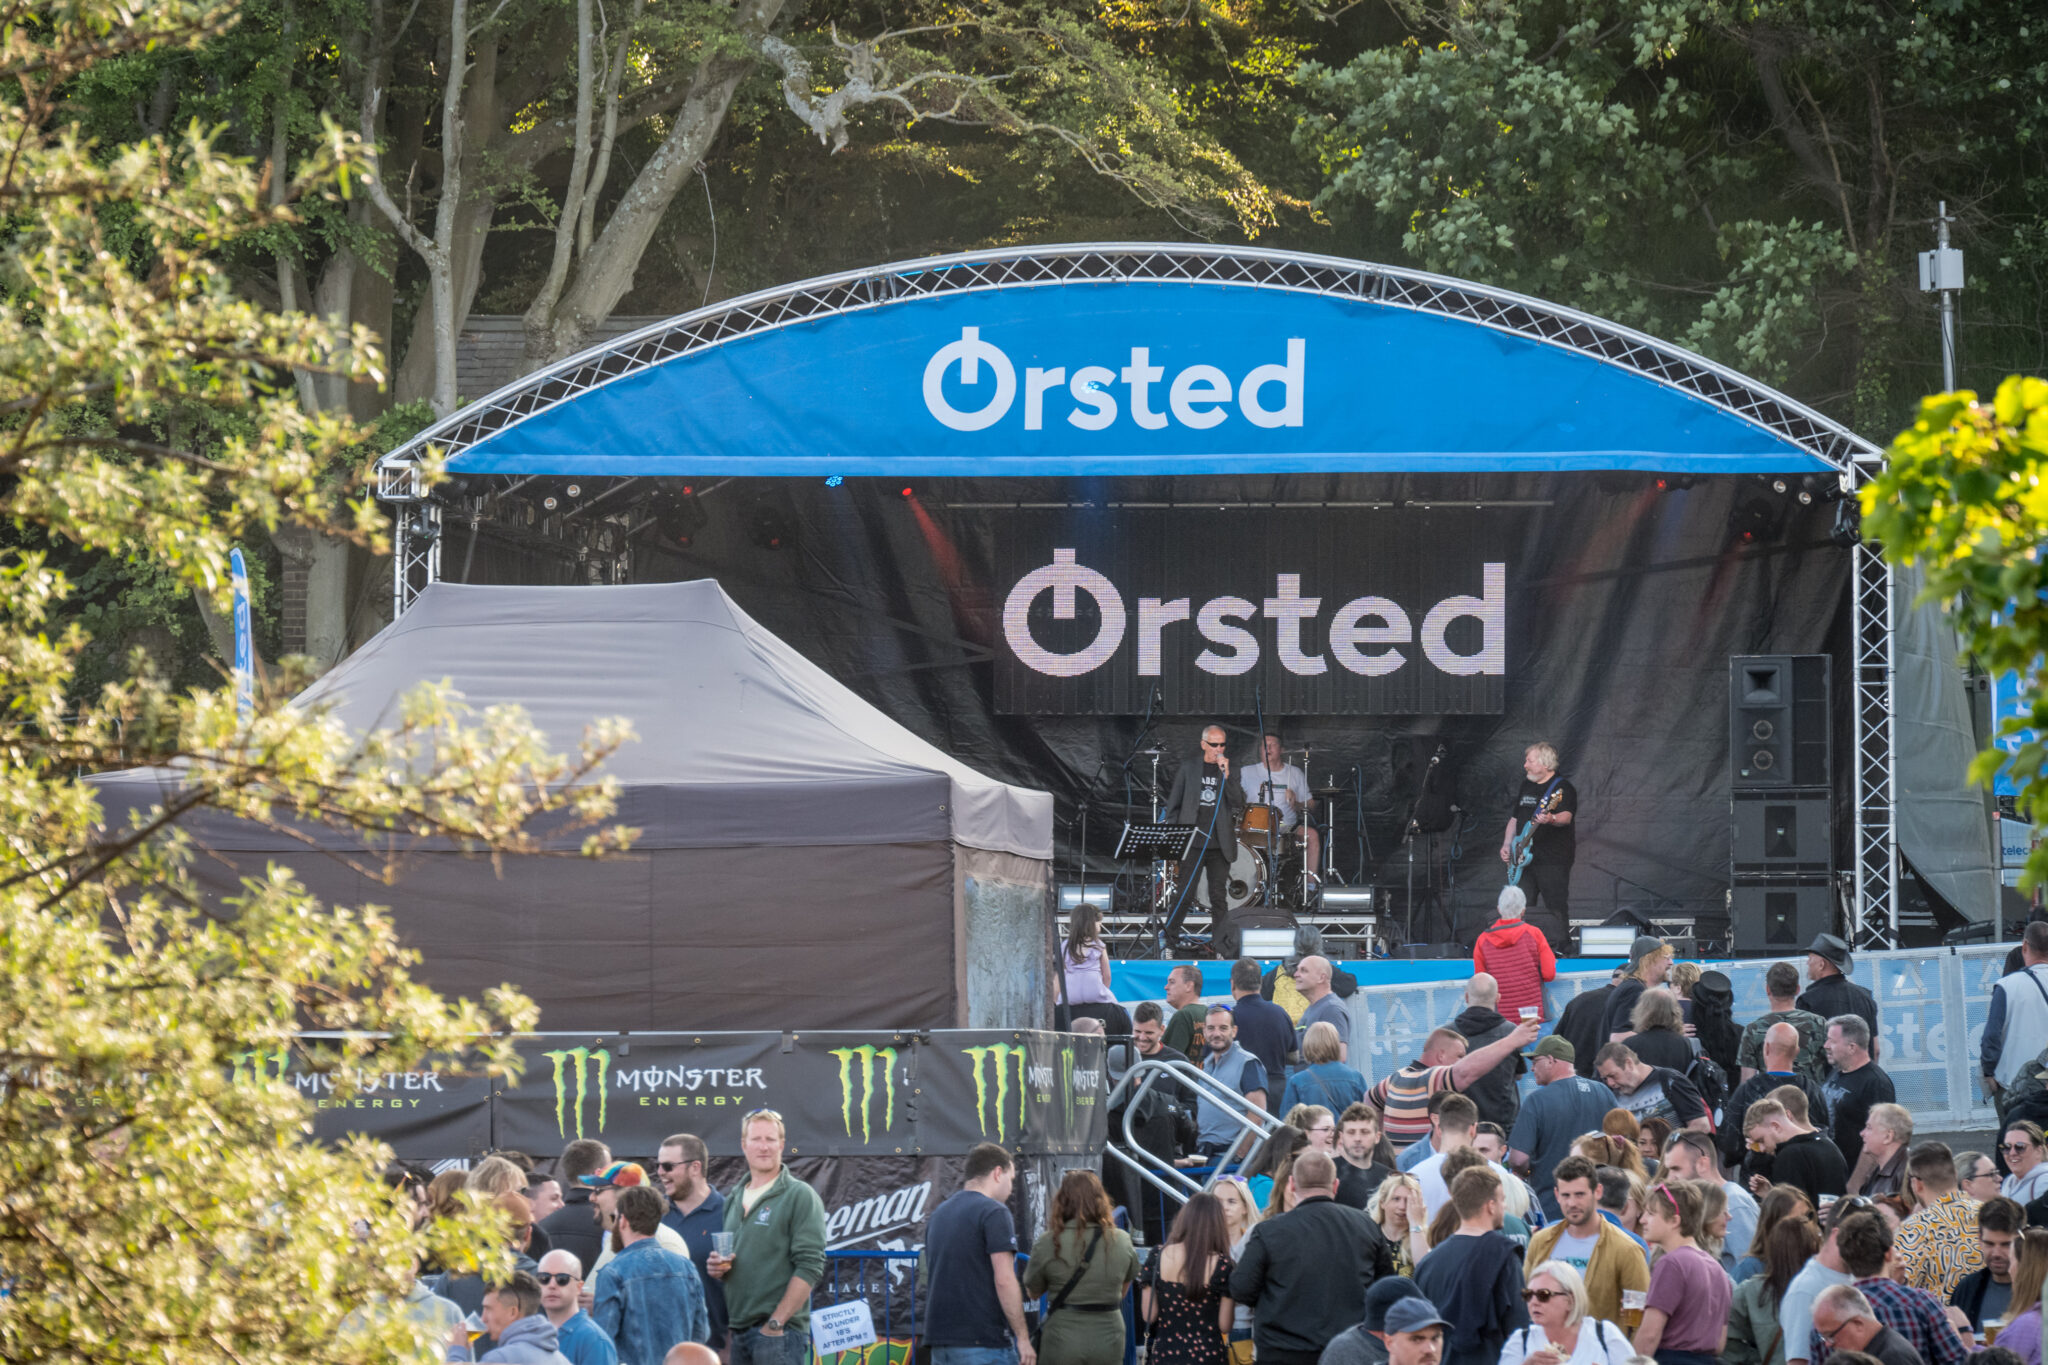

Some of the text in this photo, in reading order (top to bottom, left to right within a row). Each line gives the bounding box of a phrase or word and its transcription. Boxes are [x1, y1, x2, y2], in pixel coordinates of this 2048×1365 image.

[318, 1098, 421, 1109] ENERGY
[639, 1096, 745, 1107] ENERGY
[828, 1282, 897, 1294] LAGER
[822, 1308, 856, 1321] STRICTLY
[822, 1315, 859, 1330] NO UNDER
[823, 1338, 845, 1349] AFTER
[846, 1334, 862, 1343] 9PM
